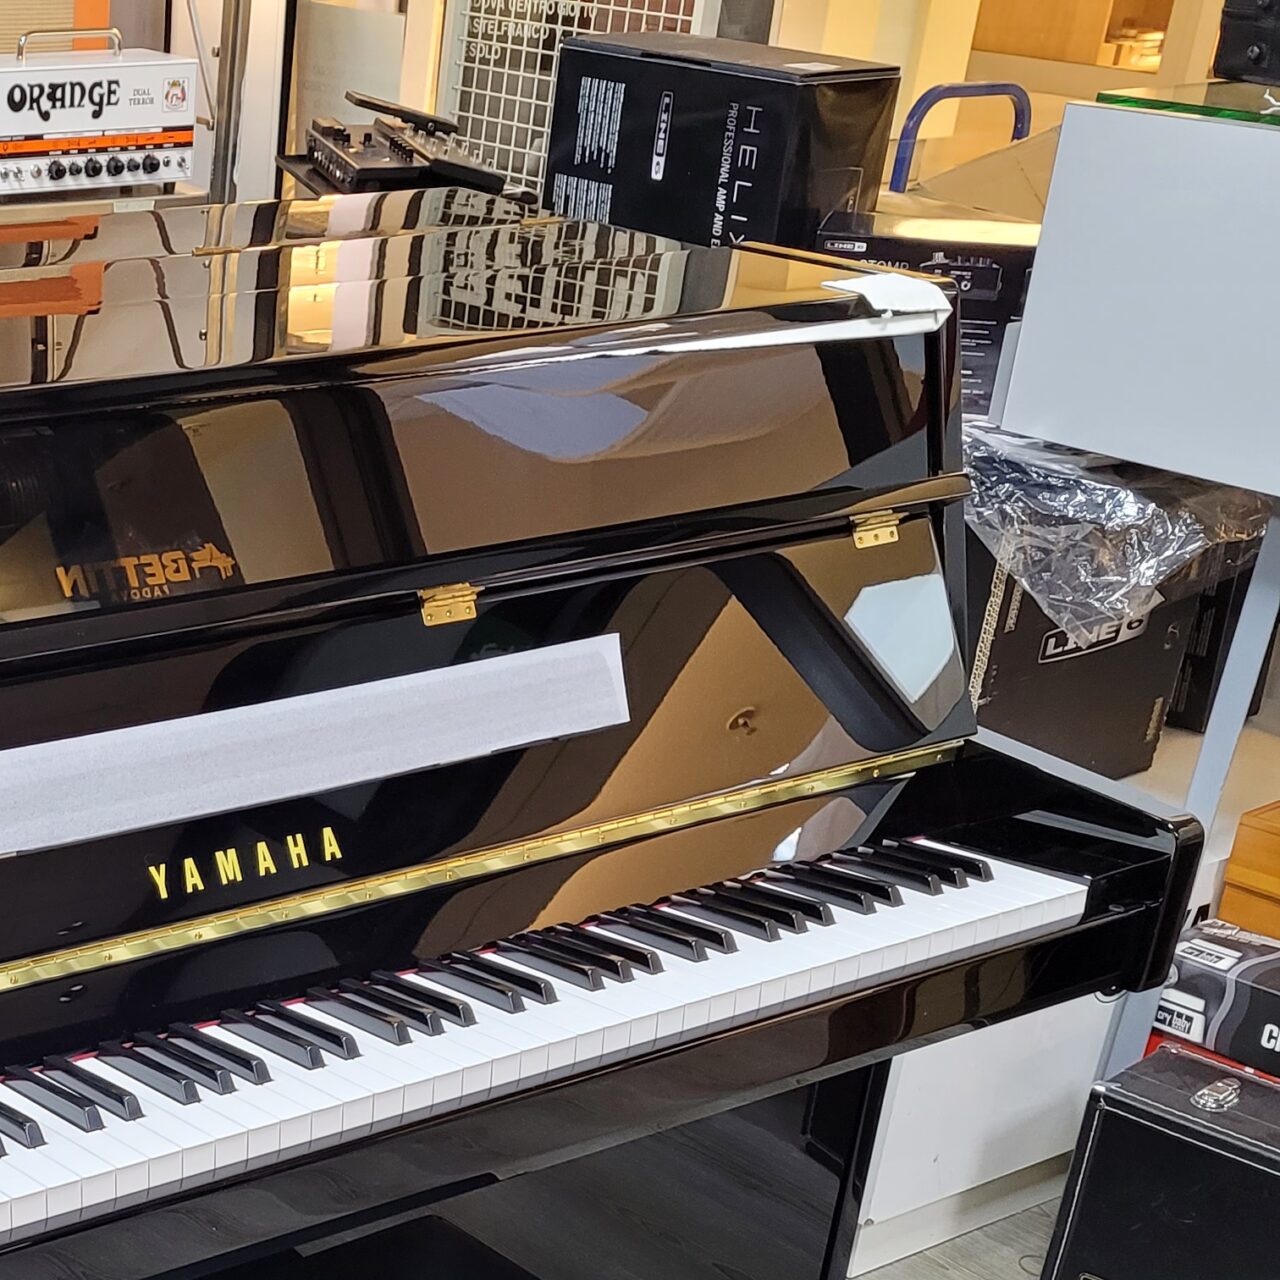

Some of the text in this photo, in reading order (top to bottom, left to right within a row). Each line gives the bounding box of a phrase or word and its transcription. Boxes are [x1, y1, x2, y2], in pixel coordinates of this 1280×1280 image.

[6, 80, 121, 122] ORANGE
[128, 97, 155, 107] TERROR
[132, 88, 152, 97] DUAL
[655, 97, 672, 154] LINE
[718, 102, 740, 185] PROFESSIONAL
[715, 186, 728, 212] AMP
[712, 212, 724, 237] AND
[860, 259, 910, 270] TOMP
[147, 826, 343, 900] YAMAHA
[1157, 1010, 1172, 1026] cry
[1172, 1010, 1191, 1033] baby
